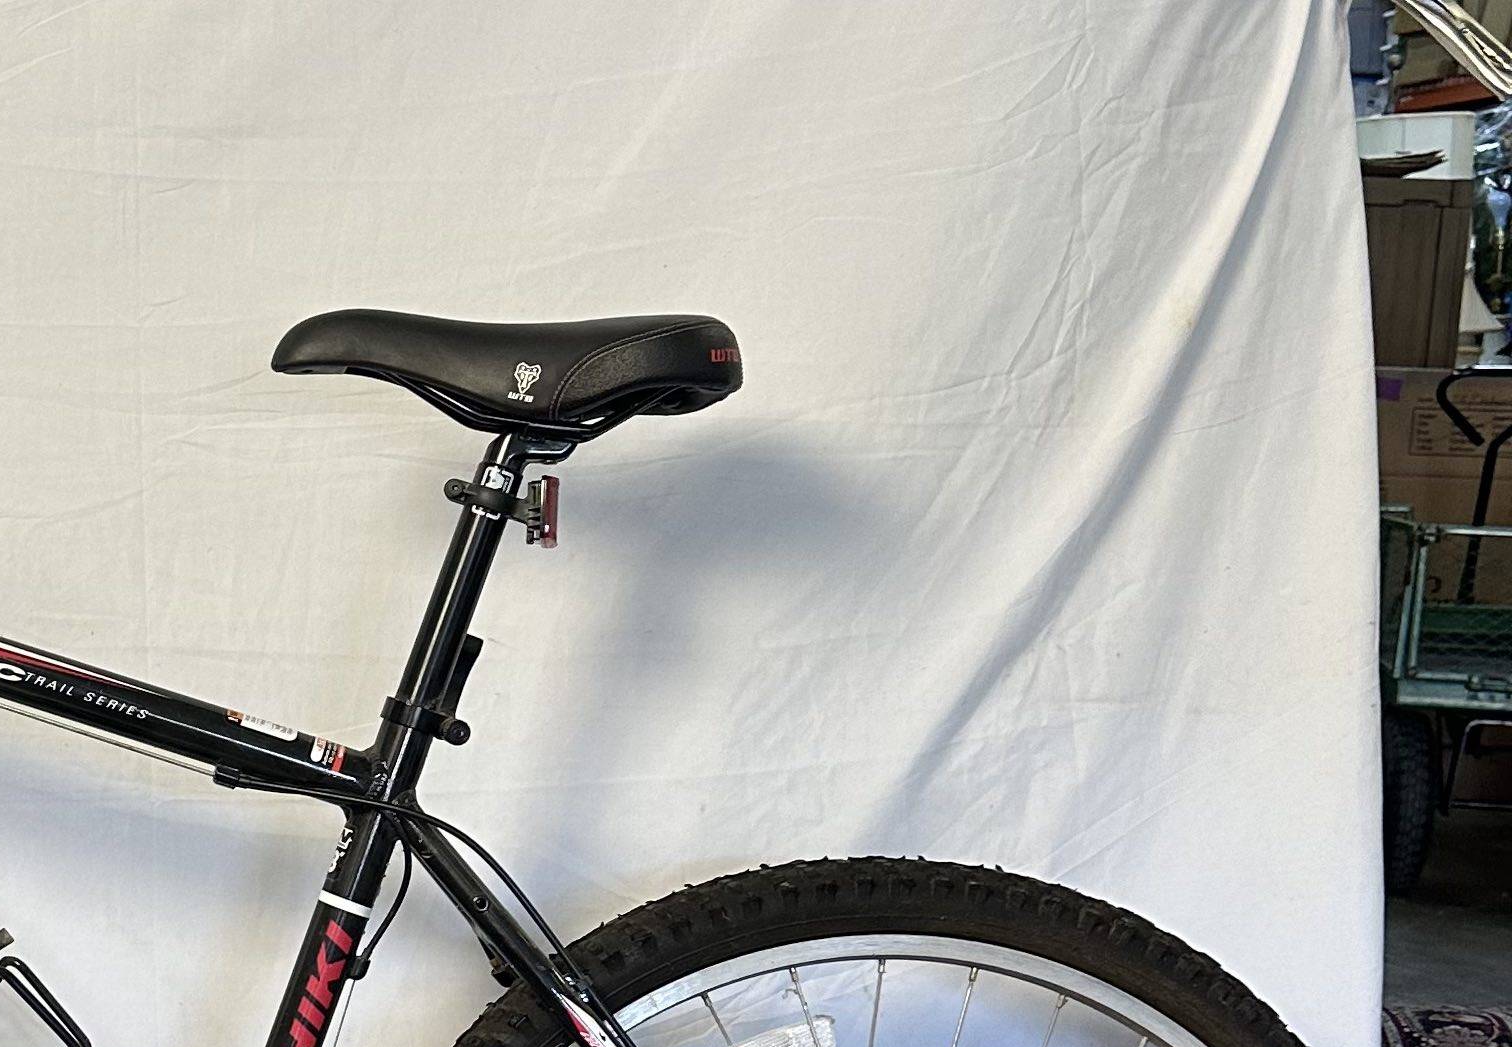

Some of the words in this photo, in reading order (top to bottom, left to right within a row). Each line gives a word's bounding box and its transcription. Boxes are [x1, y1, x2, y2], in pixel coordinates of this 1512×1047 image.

[507, 391, 535, 403] WTB
[24, 671, 74, 697] TRAIL
[83, 690, 151, 720] SERIES
